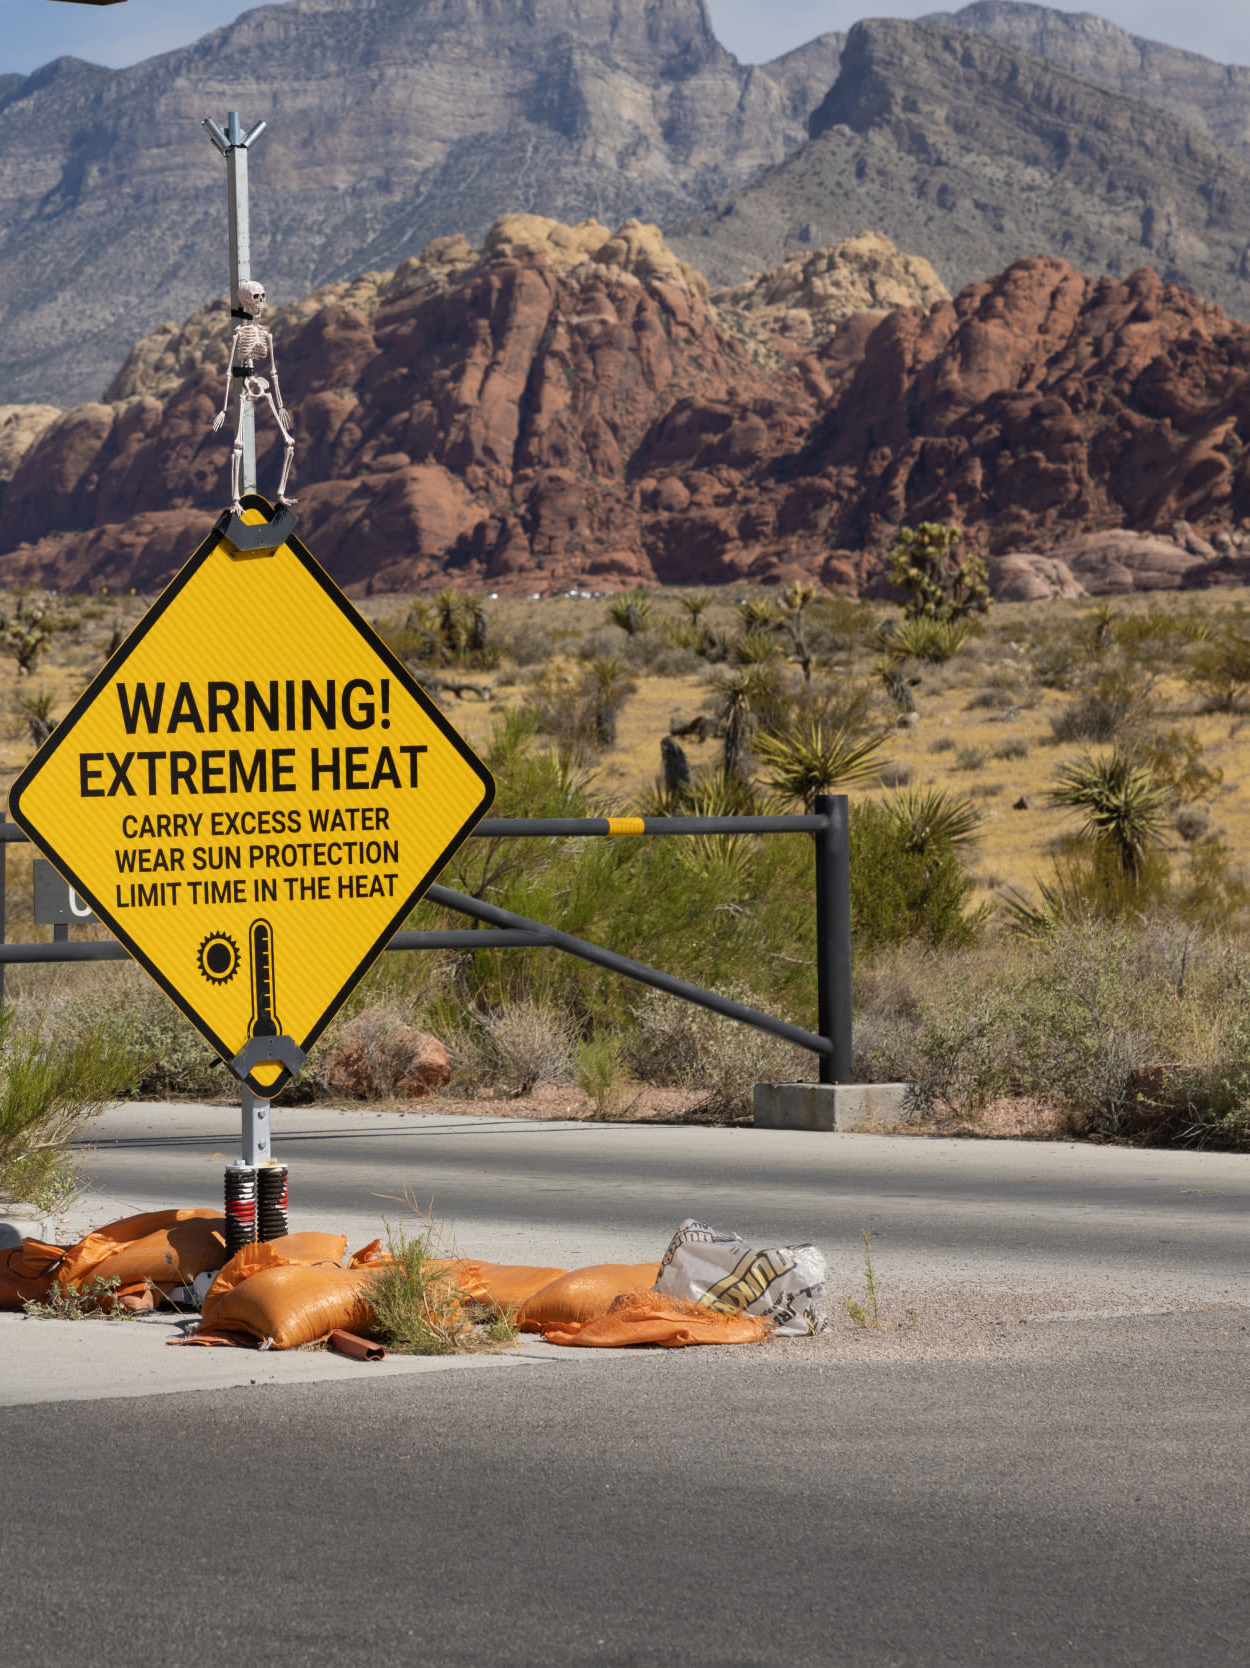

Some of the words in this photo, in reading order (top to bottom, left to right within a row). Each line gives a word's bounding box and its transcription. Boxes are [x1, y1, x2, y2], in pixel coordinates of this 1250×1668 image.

[117, 678, 392, 735] WARNING!
[80, 749, 297, 798] EXTREME
[311, 745, 428, 791] HEAT
[122, 813, 203, 839] CARRY
[211, 810, 302, 836] EXCESS
[309, 807, 390, 833] WATER
[115, 847, 185, 873] WEAR
[192, 846, 241, 870] SUN
[249, 840, 399, 869] PROTECTION
[116, 883, 182, 908] LIMIT
[186, 879, 247, 905] TIME
[254, 878, 277, 902] IN
[285, 876, 331, 901] THE
[337, 873, 399, 899] HEAT
